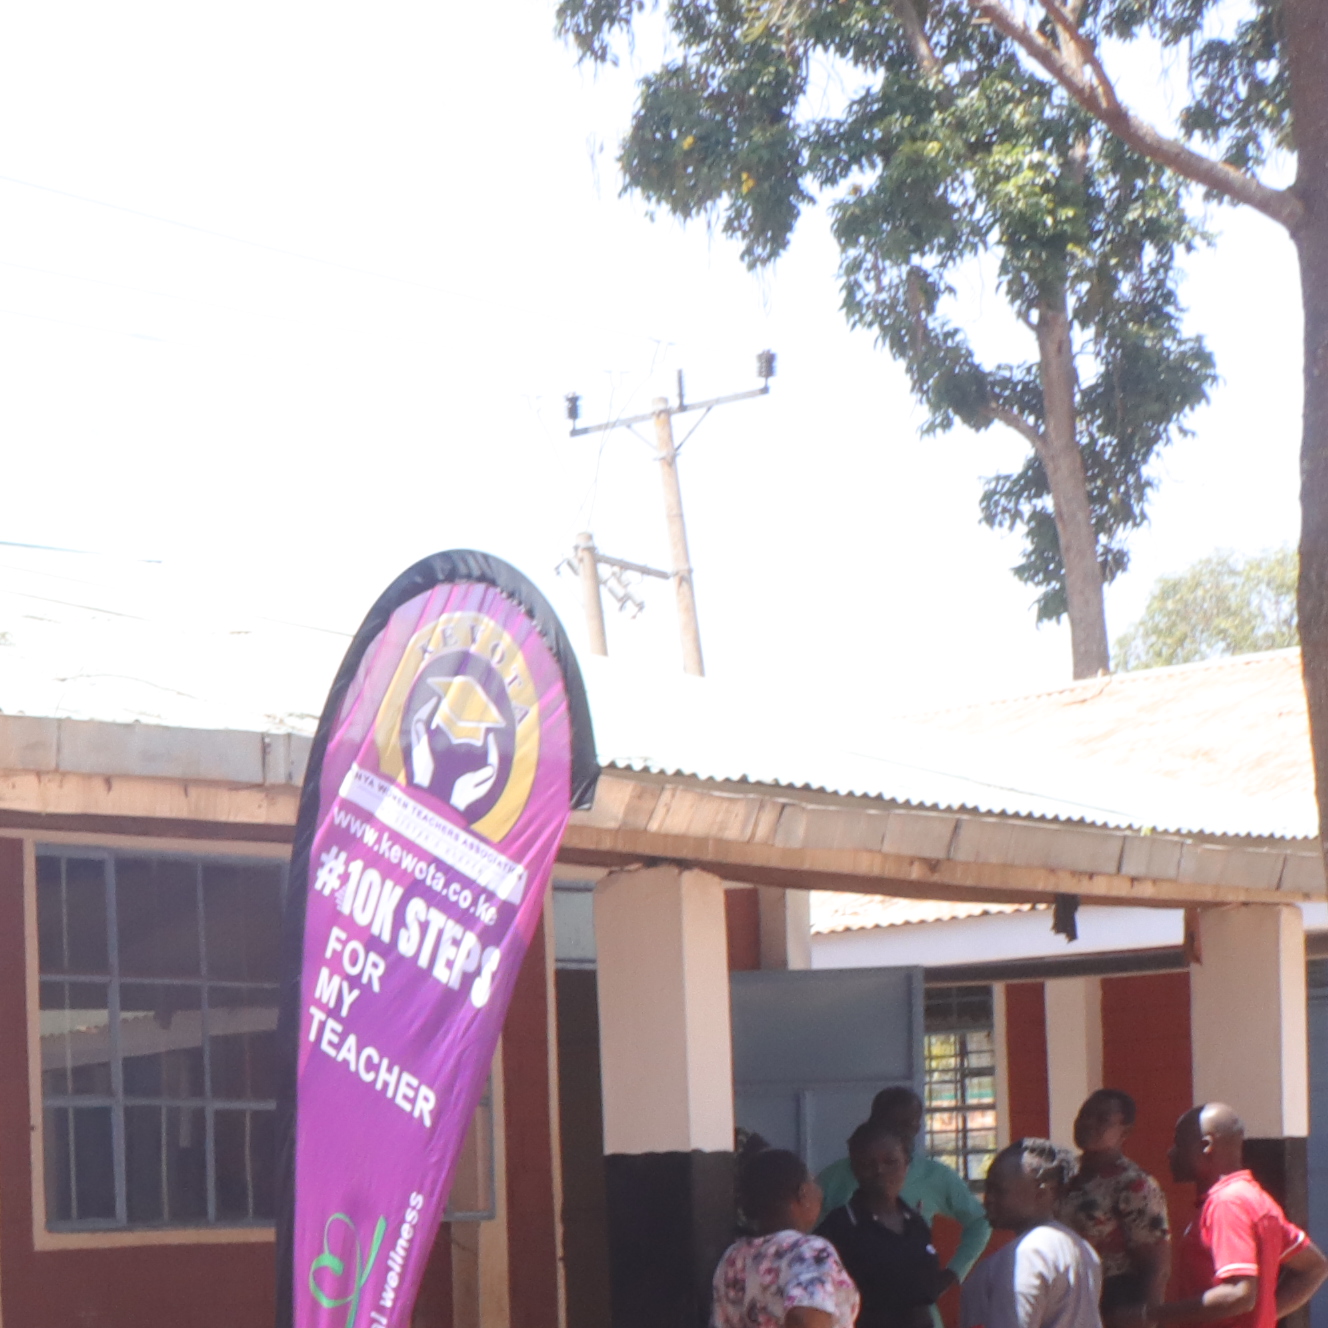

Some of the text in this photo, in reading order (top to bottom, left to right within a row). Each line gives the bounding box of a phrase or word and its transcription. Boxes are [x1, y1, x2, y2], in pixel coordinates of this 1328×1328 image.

[333, 807, 497, 926] www.kewota.co.ke
[314, 845, 404, 944] #10K
[397, 896, 501, 1008] STEPS
[324, 925, 385, 993] FOR
[314, 966, 360, 1018] MY
[307, 1006, 436, 1128] TEACHER
[381, 1190, 424, 1308] wellness
